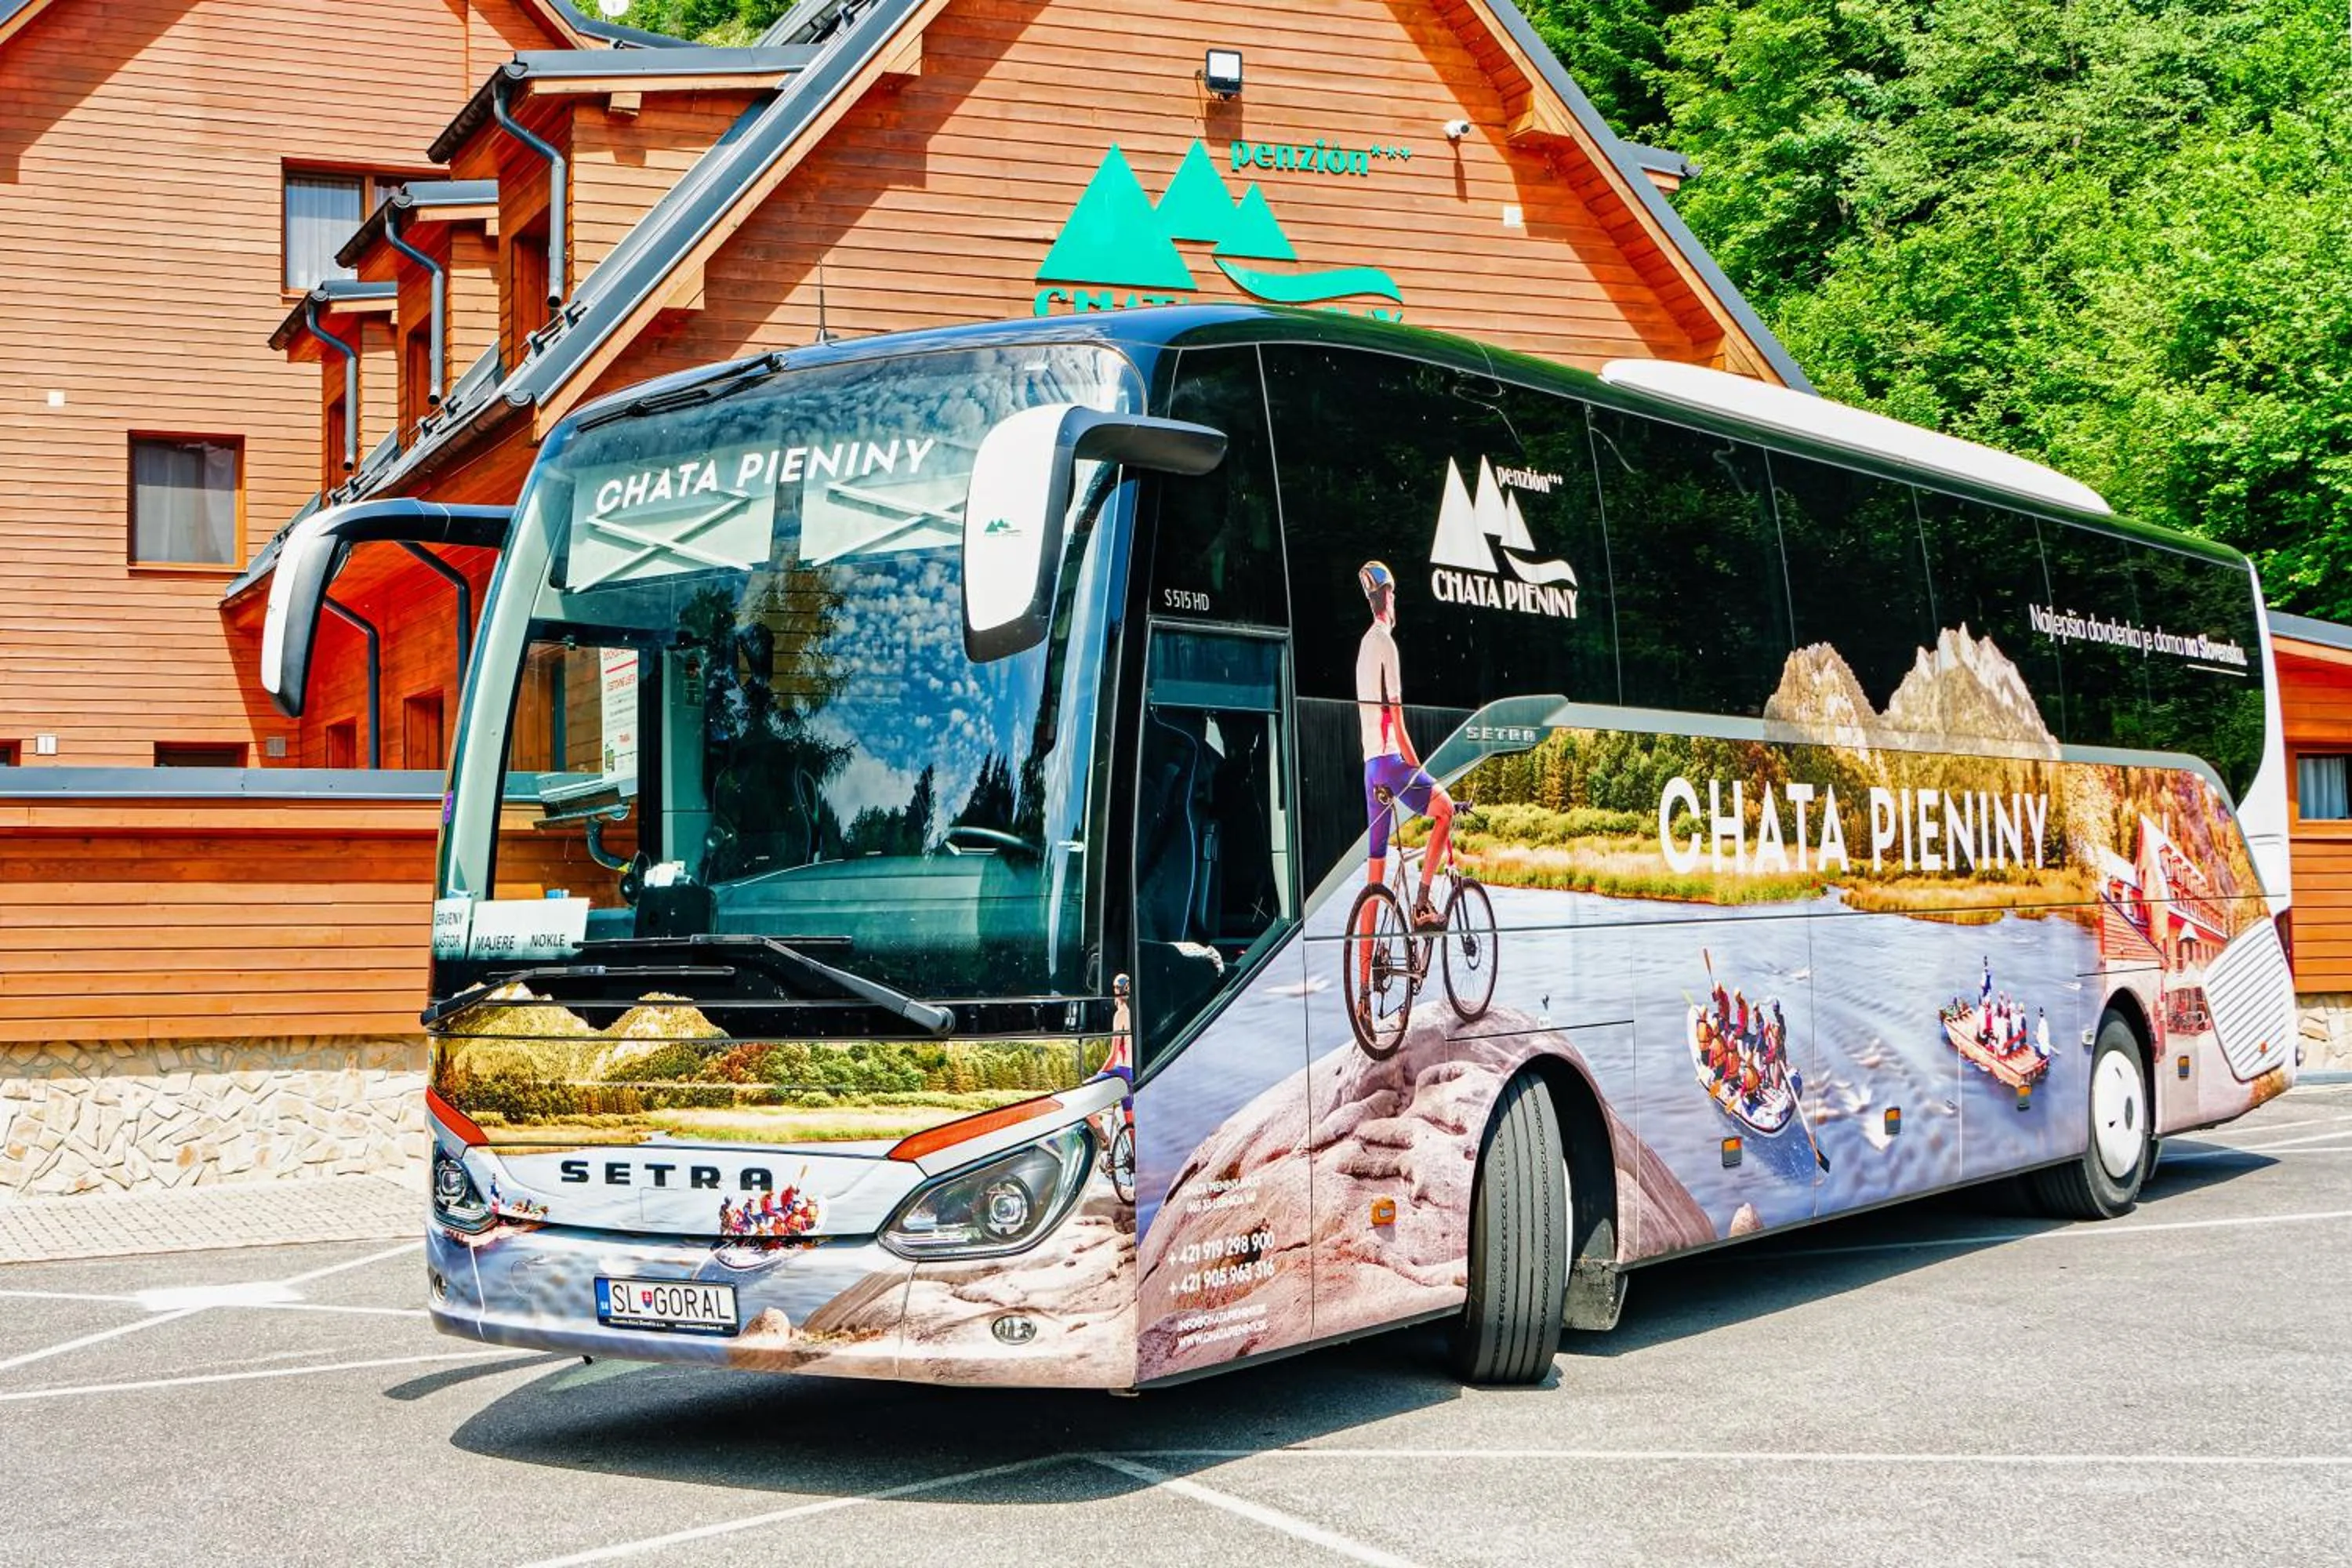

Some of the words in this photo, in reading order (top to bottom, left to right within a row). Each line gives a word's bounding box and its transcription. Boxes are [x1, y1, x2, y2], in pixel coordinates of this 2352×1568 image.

[594, 457, 720, 514] CHATA
[735, 437, 937, 488] PIENINY
[1173, 589, 1192, 609] 515
[1192, 592, 1210, 611] HD
[1431, 567, 1501, 609] CHATA
[1502, 579, 1578, 619] PIENINY
[2028, 603, 2086, 645] Najlepšia
[2087, 612, 2142, 649] dovolenka
[2140, 624, 2154, 658] je
[2154, 625, 2185, 656] doma
[1465, 726, 1537, 742] SETRA
[1658, 776, 1850, 874] CHATA
[1869, 786, 2049, 872] PIENINY
[474, 935, 515, 951] MAJERE
[529, 933, 566, 948] NOKLE
[560, 1160, 773, 1191] SETRA
[1179, 1243, 1200, 1264] 421
[1203, 1239, 1223, 1260] 919
[1225, 1235, 1249, 1256] 298
[1250, 1230, 1275, 1251] 900
[1180, 1272, 1201, 1293] 421
[1203, 1267, 1227, 1289] 905
[1229, 1261, 1253, 1284] 963
[1254, 1257, 1275, 1279] 316
[612, 1283, 641, 1314] SL
[653, 1287, 731, 1319] GORAL
